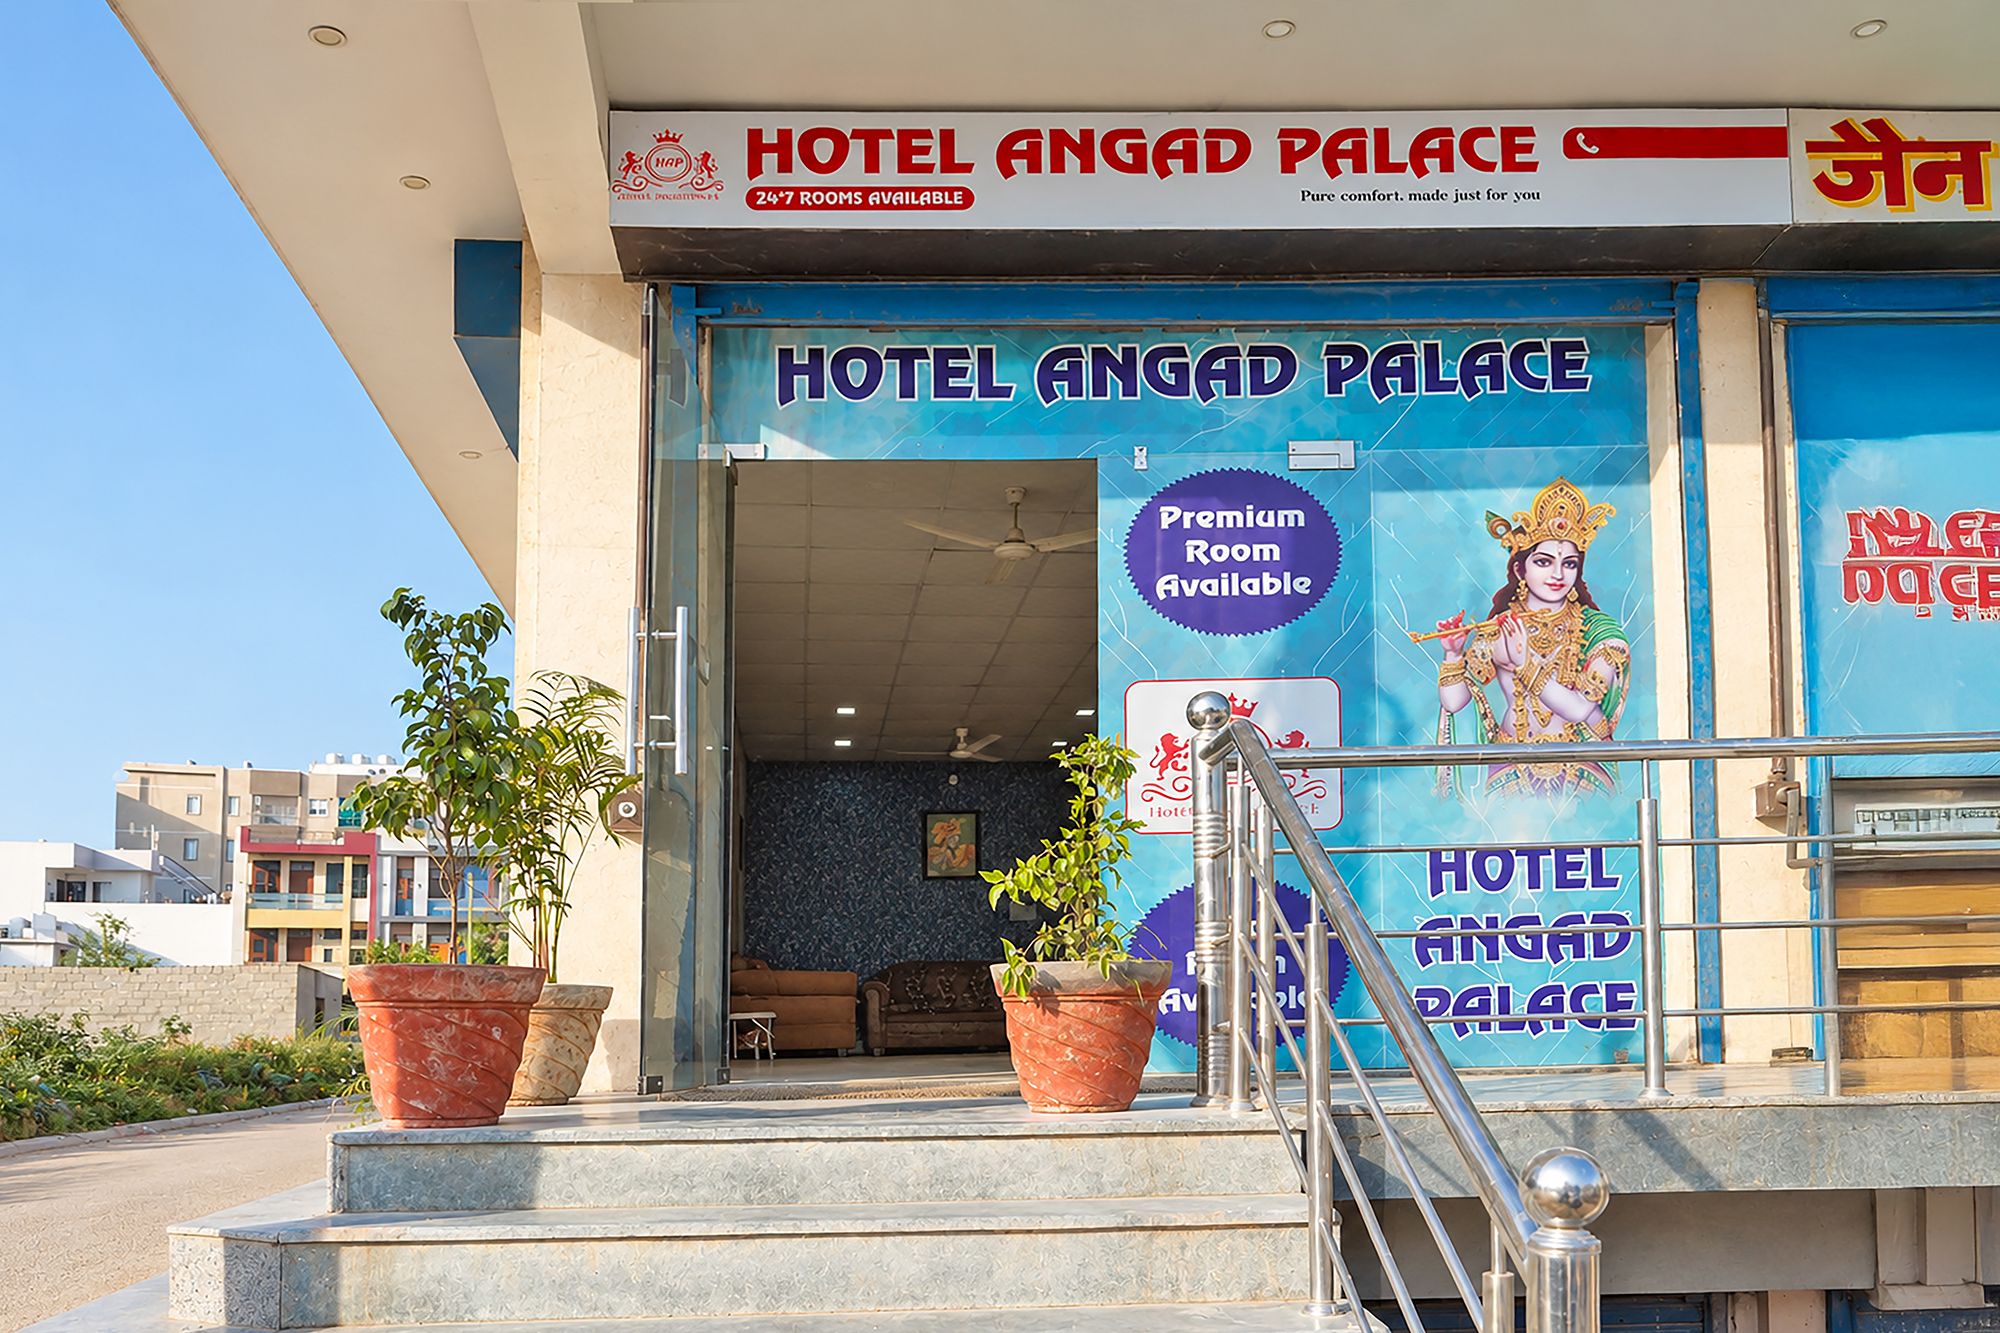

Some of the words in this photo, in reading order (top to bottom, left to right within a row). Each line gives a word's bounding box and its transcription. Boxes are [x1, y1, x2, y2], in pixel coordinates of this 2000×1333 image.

[656, 157, 684, 168] HAP
[747, 127, 975, 181] HOTEL
[996, 126, 1252, 181] ANGAD
[1277, 125, 1540, 180] PALACE
[1805, 117, 2000, 212] जैन
[799, 190, 863, 207] ROOMS
[867, 190, 964, 207] AVAILABLE
[1300, 189, 1336, 202] Pure
[1408, 188, 1449, 202] made
[1452, 187, 1482, 203] just
[1486, 187, 1509, 202] for
[1513, 191, 1541, 204] you
[775, 344, 1017, 409] HOTEL
[1034, 341, 1299, 409] ANGAD
[1321, 336, 1593, 404] PALACE
[1159, 504, 1305, 530] Premium
[1185, 539, 1281, 566] Room
[1155, 571, 1312, 601] Available
[1426, 847, 1623, 901] HOTEL
[1412, 911, 1634, 971] ANGAD
